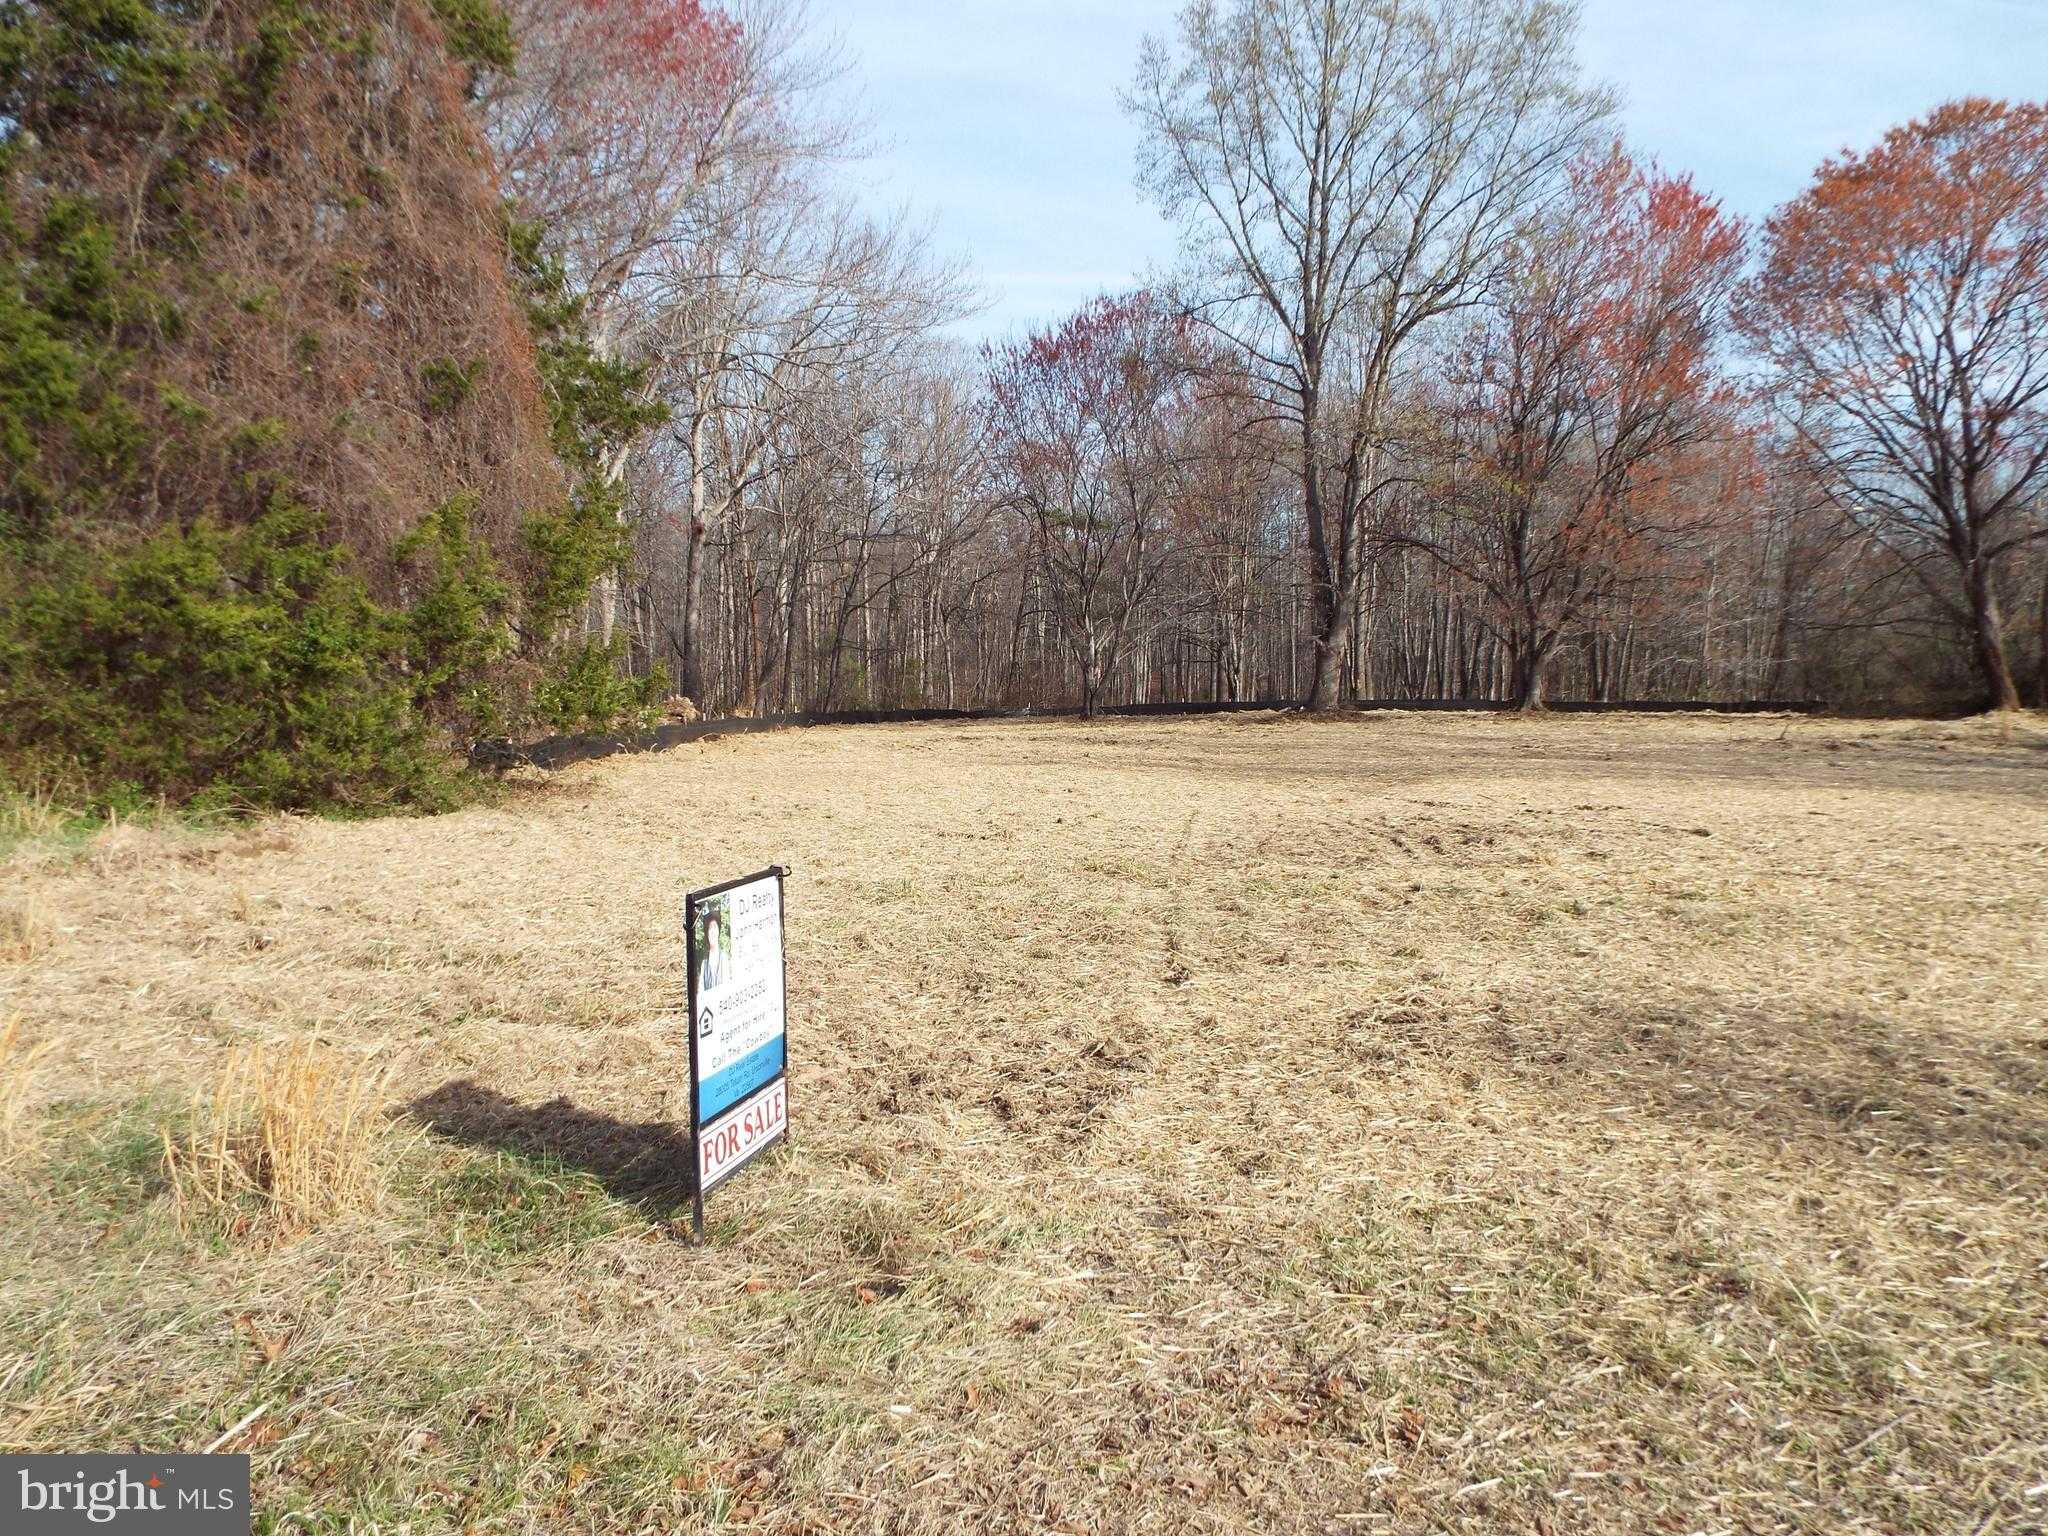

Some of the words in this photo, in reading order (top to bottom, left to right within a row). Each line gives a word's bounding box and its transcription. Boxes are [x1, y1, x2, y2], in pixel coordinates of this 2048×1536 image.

[739, 897, 749, 916] DJ
[752, 891, 774, 909] Realty
[719, 1024, 741, 1044] Agent
[742, 1018, 751, 1031] for
[711, 1050, 726, 1069] Call
[727, 1043, 741, 1058] The
[703, 1123, 740, 1175] FOR
[744, 1092, 782, 1145] SALE
